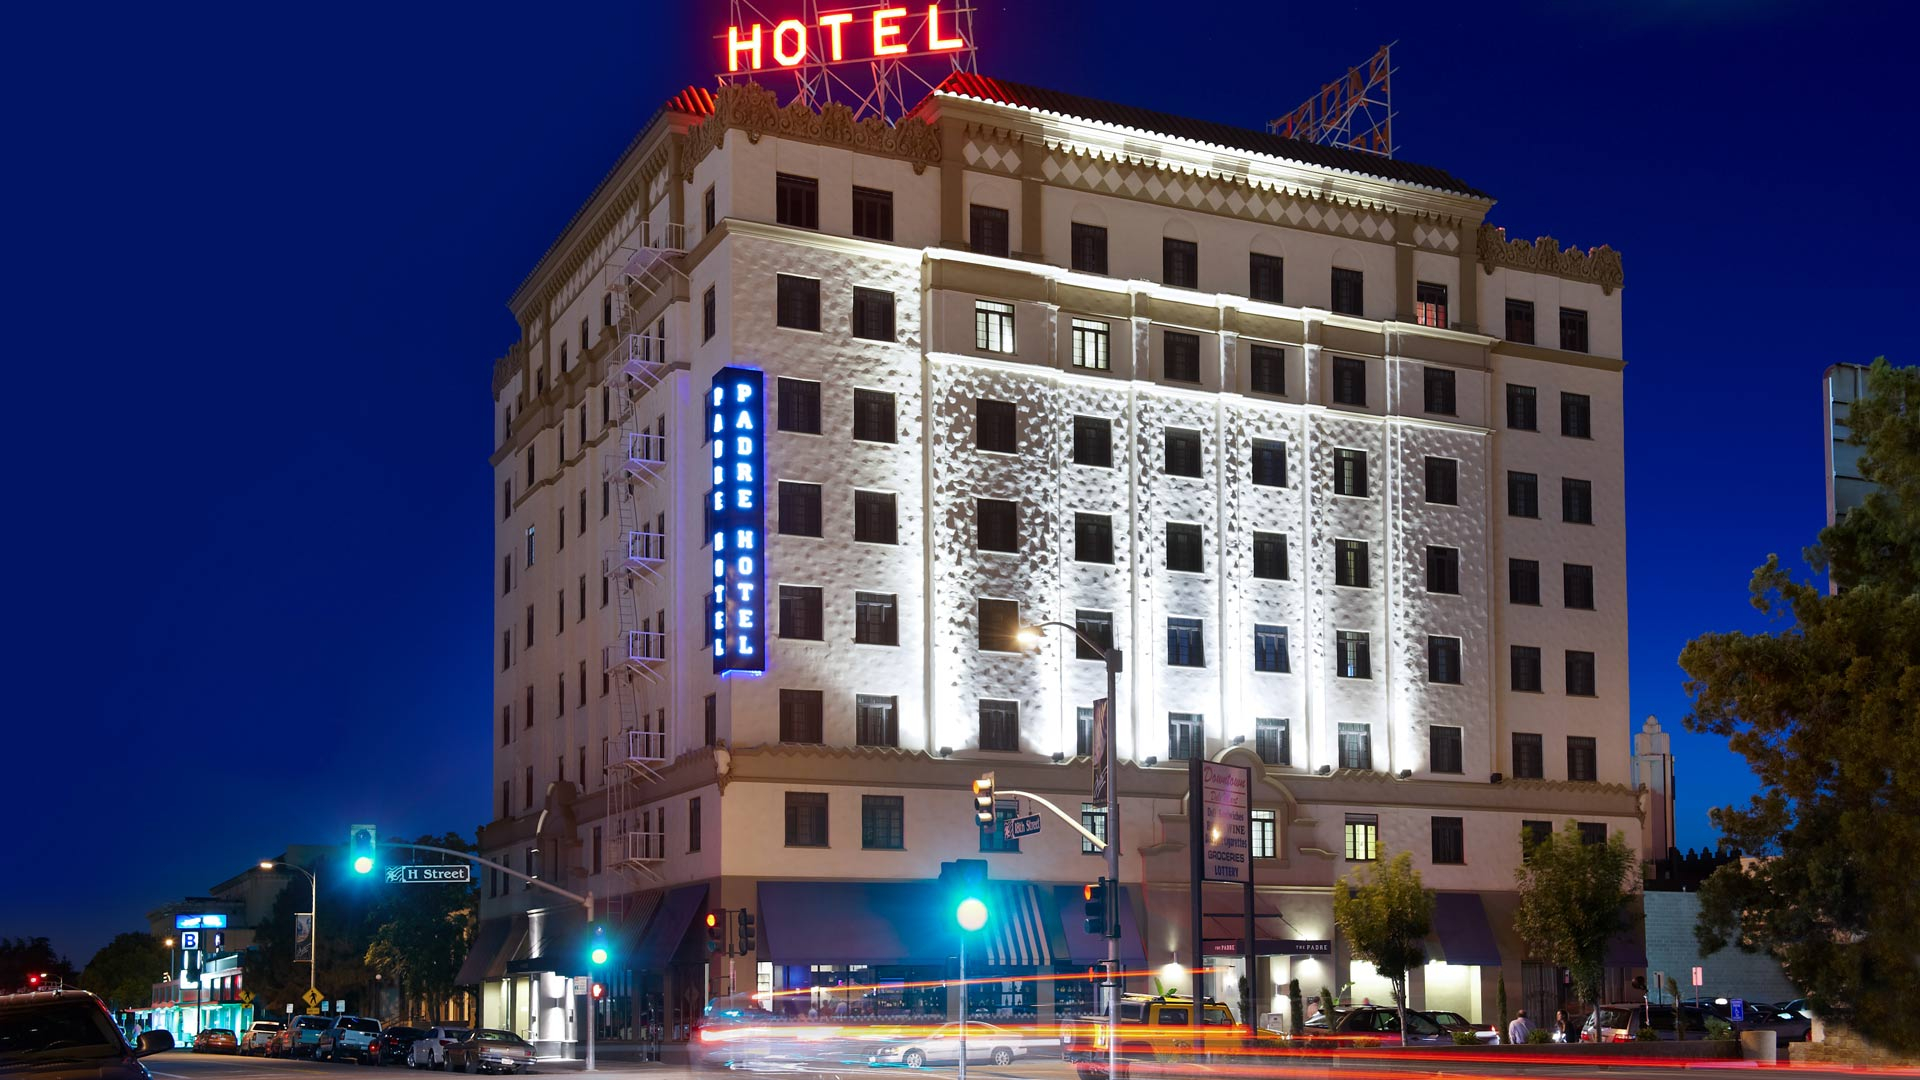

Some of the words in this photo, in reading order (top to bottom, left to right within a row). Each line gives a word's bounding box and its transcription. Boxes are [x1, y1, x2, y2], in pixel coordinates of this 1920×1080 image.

[728, 4, 964, 72] HOTEL
[736, 383, 753, 508] PADRE
[737, 529, 753, 655] HOTEL
[1204, 766, 1246, 788] Downtown
[1218, 809, 1244, 821] Swiches
[1227, 823, 1246, 835] WINE
[1208, 850, 1244, 863] GROCERIES
[408, 869, 418, 879] H
[423, 869, 465, 879] Street
[1214, 865, 1239, 877] LOTTERY
[185, 933, 196, 947] B
